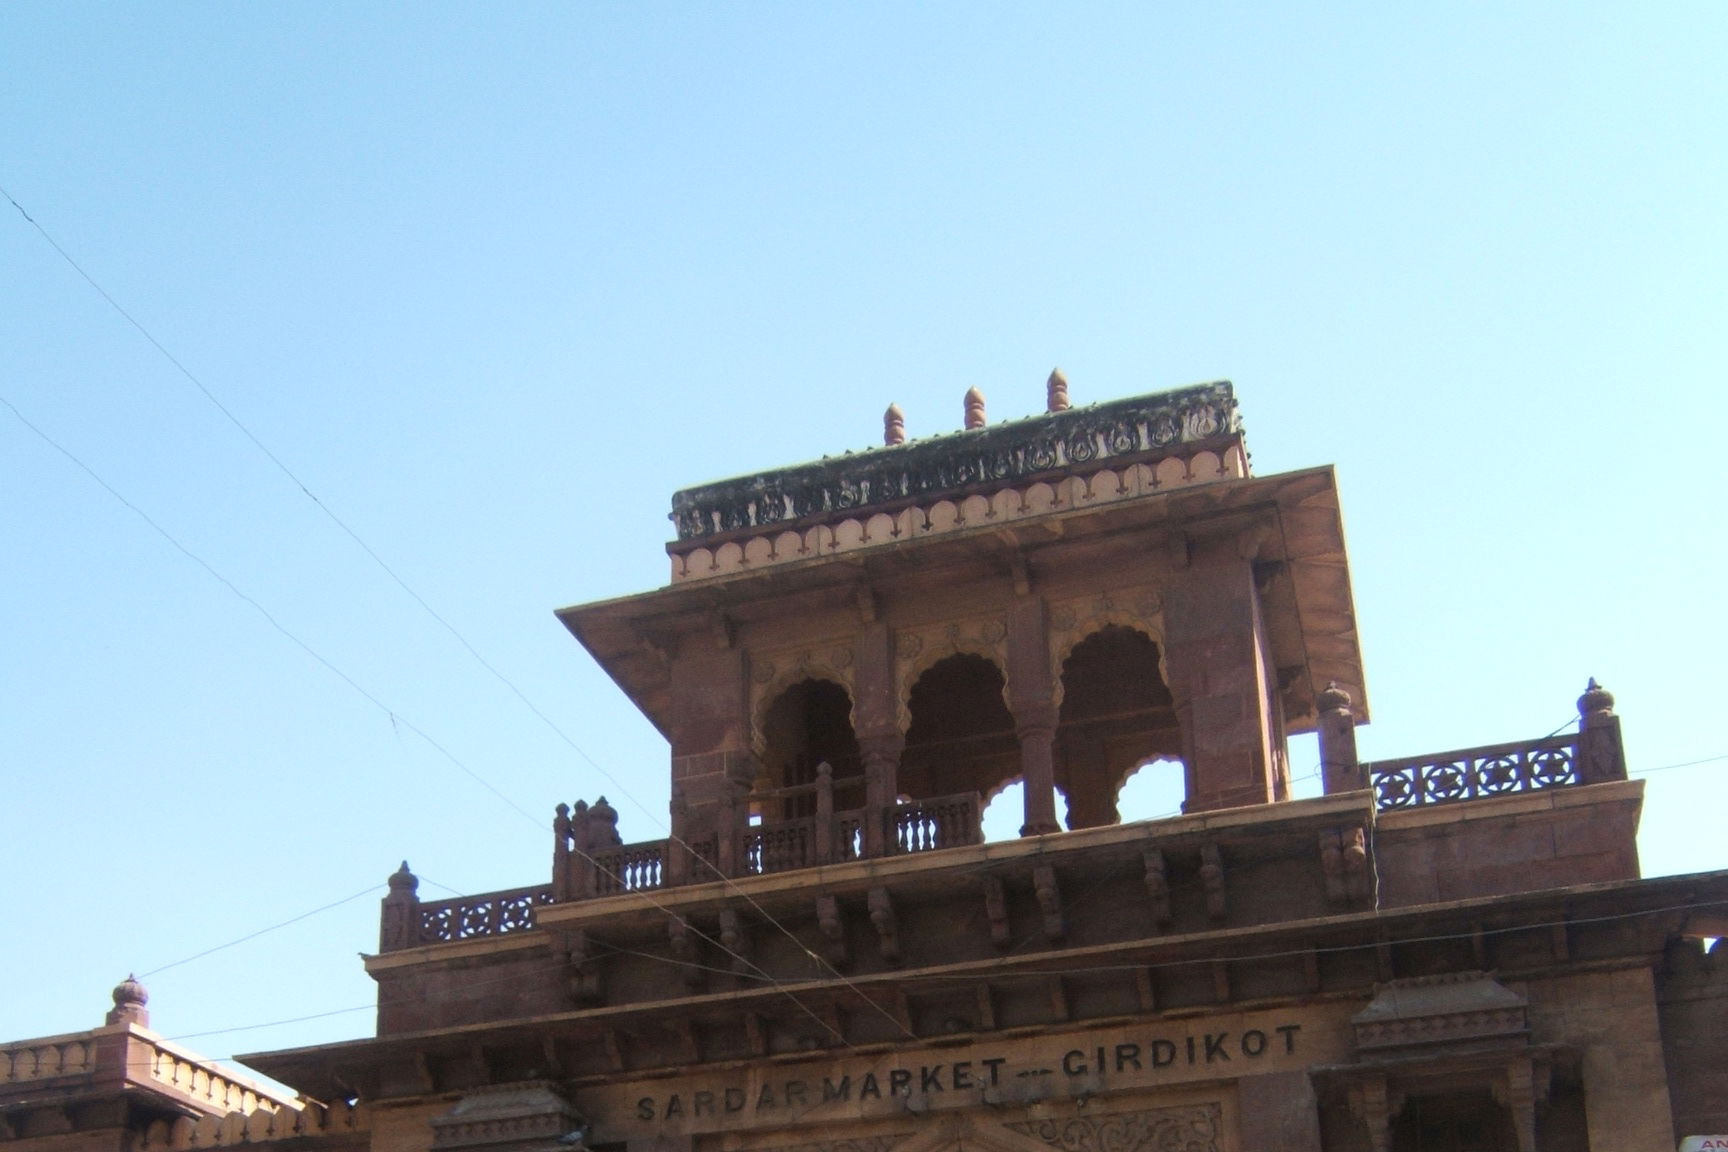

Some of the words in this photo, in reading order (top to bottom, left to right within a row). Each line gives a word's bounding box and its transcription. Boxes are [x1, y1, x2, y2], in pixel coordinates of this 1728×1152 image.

[637, 1079, 808, 1121] SARDAR
[822, 1057, 1006, 1103] MARKET
[1062, 1024, 1302, 1078] GIRDIKOT
